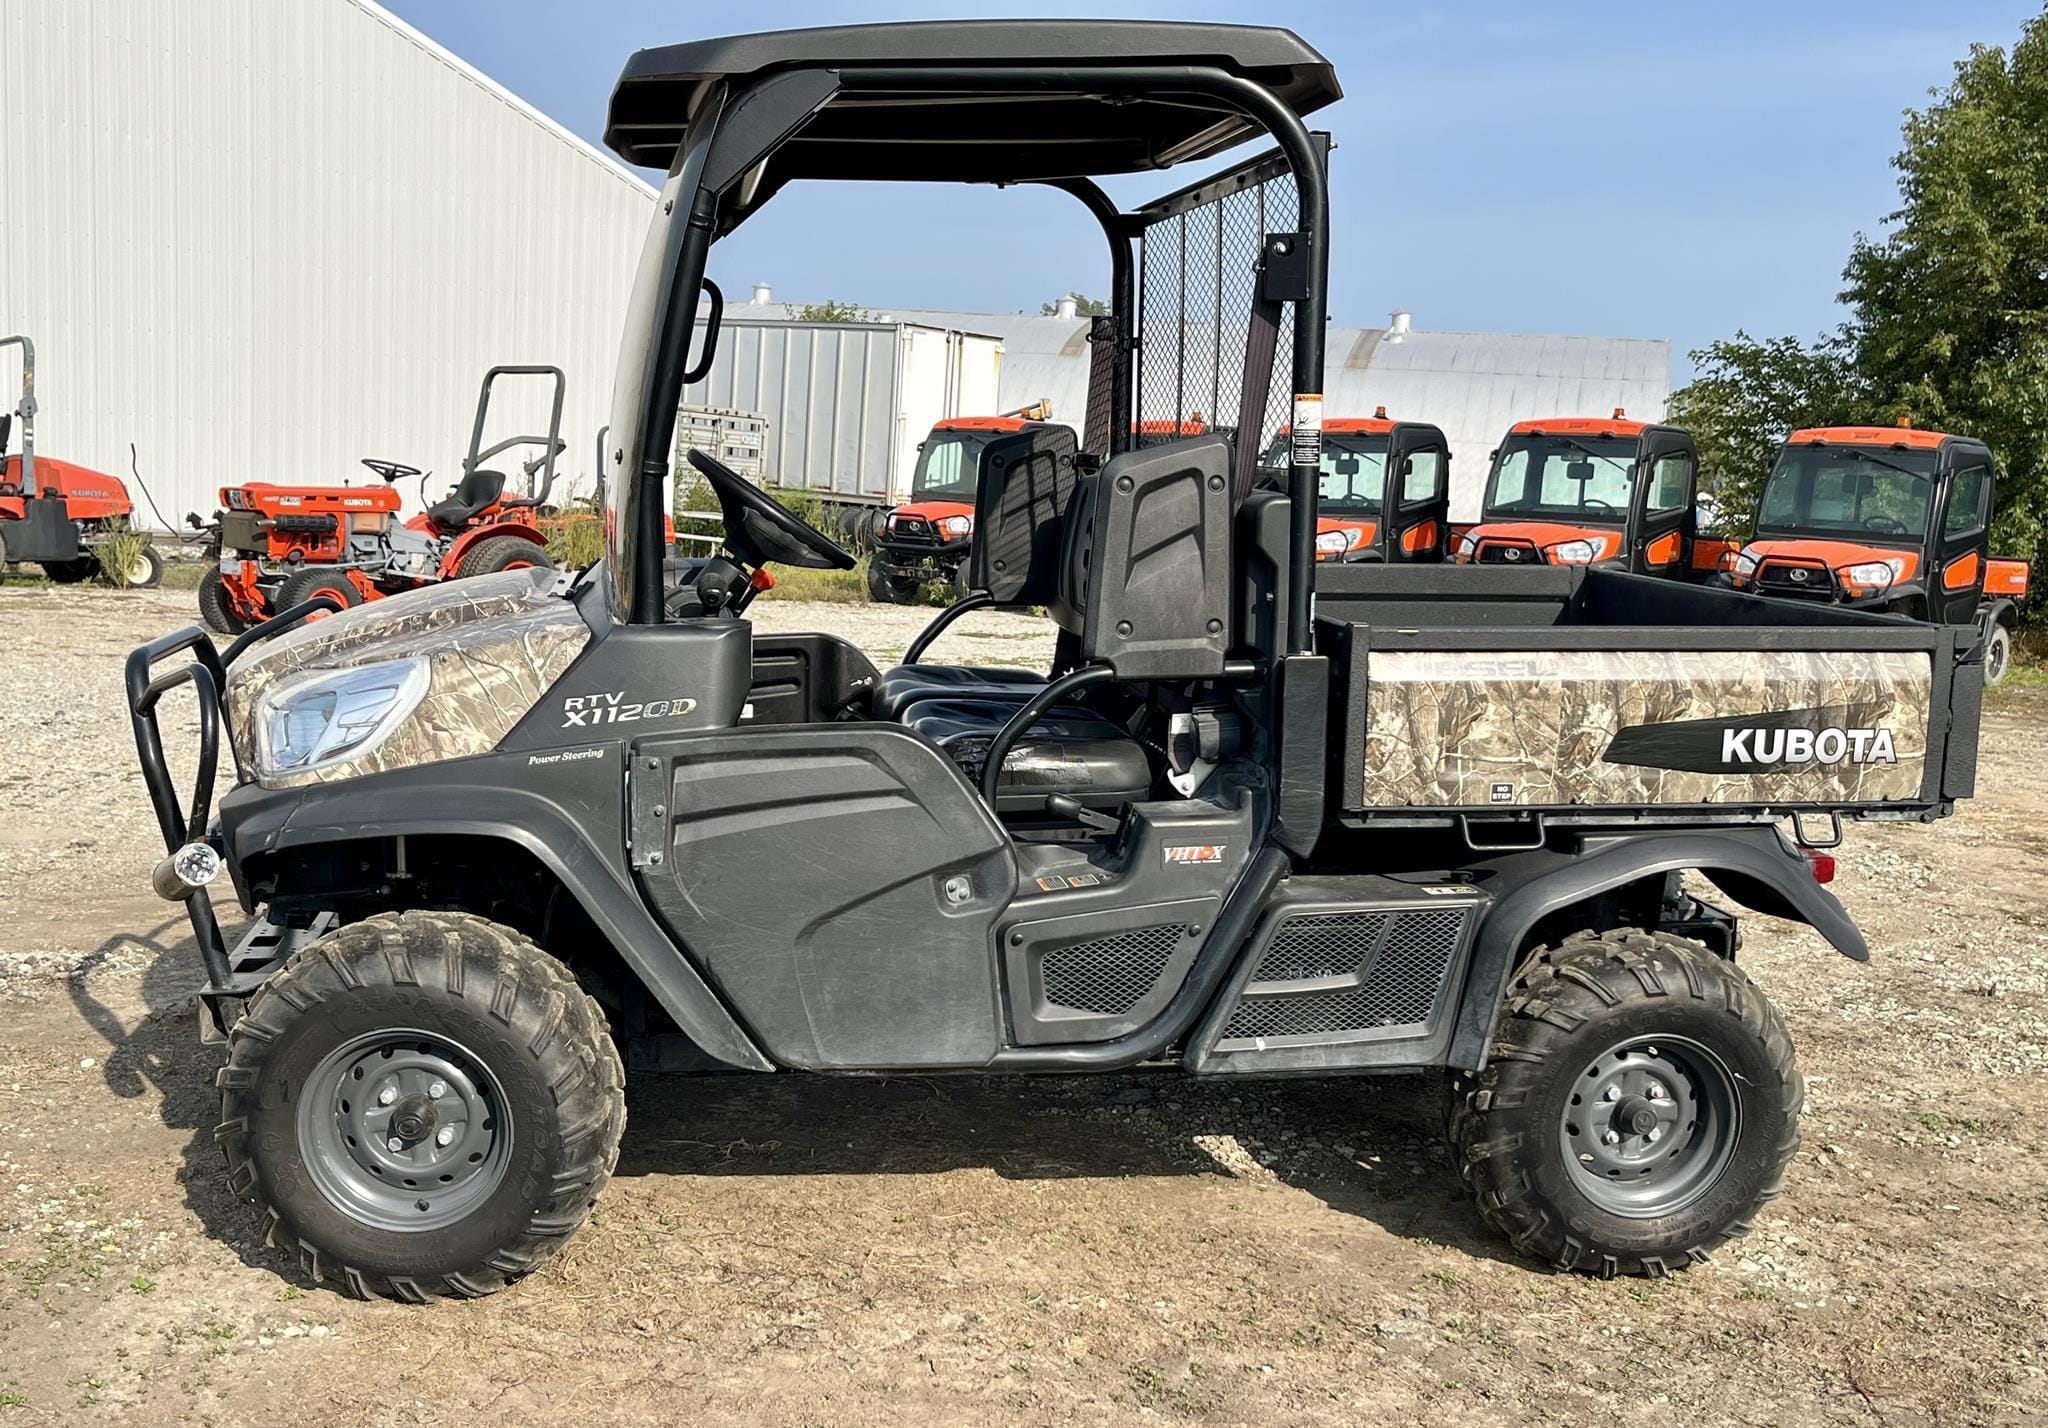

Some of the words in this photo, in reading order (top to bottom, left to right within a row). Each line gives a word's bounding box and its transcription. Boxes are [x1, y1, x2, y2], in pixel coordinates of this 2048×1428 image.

[1387, 660, 1558, 677] IESEL
[564, 692, 625, 710] RTV
[561, 698, 697, 728] X1120D
[1721, 727, 1897, 765] KUBOTA
[528, 754, 561, 765] Power
[562, 748, 604, 761] Steering
[1163, 845, 1227, 864] VHT-X
